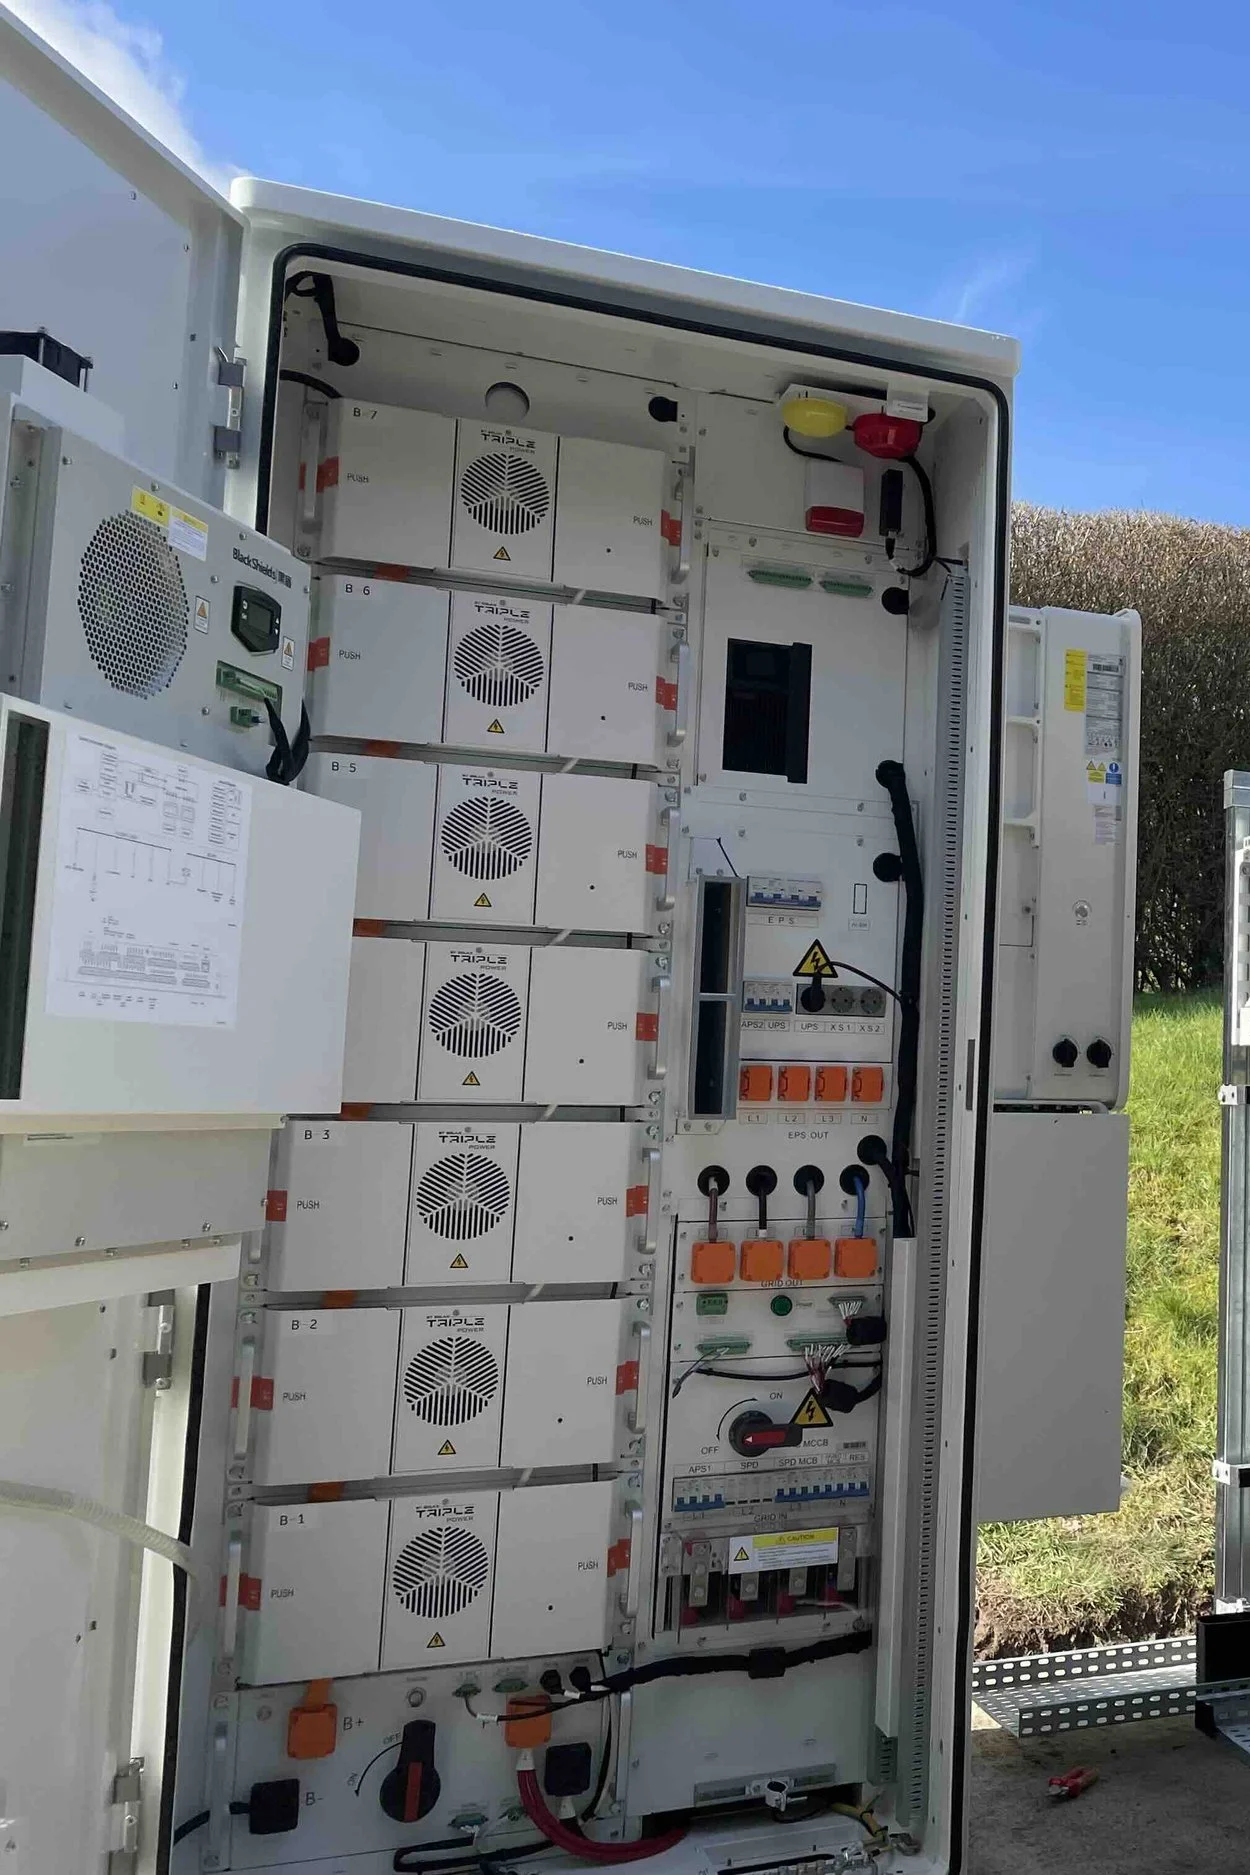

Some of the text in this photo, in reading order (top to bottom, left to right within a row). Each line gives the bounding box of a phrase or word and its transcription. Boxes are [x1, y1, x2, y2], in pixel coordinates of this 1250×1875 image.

[480, 433, 536, 449] TRIPLE
[347, 473, 369, 484] PUSH
[633, 516, 653, 526] PUSH
[233, 547, 277, 580] BlackShields
[474, 605, 530, 619] TRIPLE
[338, 650, 361, 661] PUSH
[628, 682, 648, 692] PUSH
[462, 778, 518, 790] TRIPLE
[617, 850, 637, 860] PUSH
[450, 955, 507, 965] TRIPLE
[607, 1021, 628, 1031] PUSH
[741, 1020, 786, 1029] APS2 UPS
[801, 1023, 819, 1031] UPS
[438, 1135, 496, 1143] TRIPLE
[788, 1131, 829, 1140] EPS OUT
[296, 1200, 320, 1210] PUSH
[597, 1196, 618, 1206] PUSH
[761, 1279, 803, 1288] GRID OUT
[427, 1317, 484, 1327] TRIPLE
[587, 1376, 608, 1386] PUSH
[282, 1391, 306, 1402] PUSH
[769, 1392, 783, 1400] ON
[803, 1438, 829, 1447] MCCB
[701, 1446, 719, 1455] OFF
[688, 1465, 712, 1474] APS1
[740, 1461, 759, 1470] SPD
[778, 1457, 797, 1467] SPD
[798, 1456, 818, 1465] MCB
[416, 1506, 474, 1518] TRIPLE
[753, 1512, 789, 1523] GRID IN
[786, 1533, 815, 1542] CAUTION
[577, 1561, 599, 1571] PUSH
[270, 1588, 295, 1599] PUSH
[343, 1716, 364, 1731] B+
